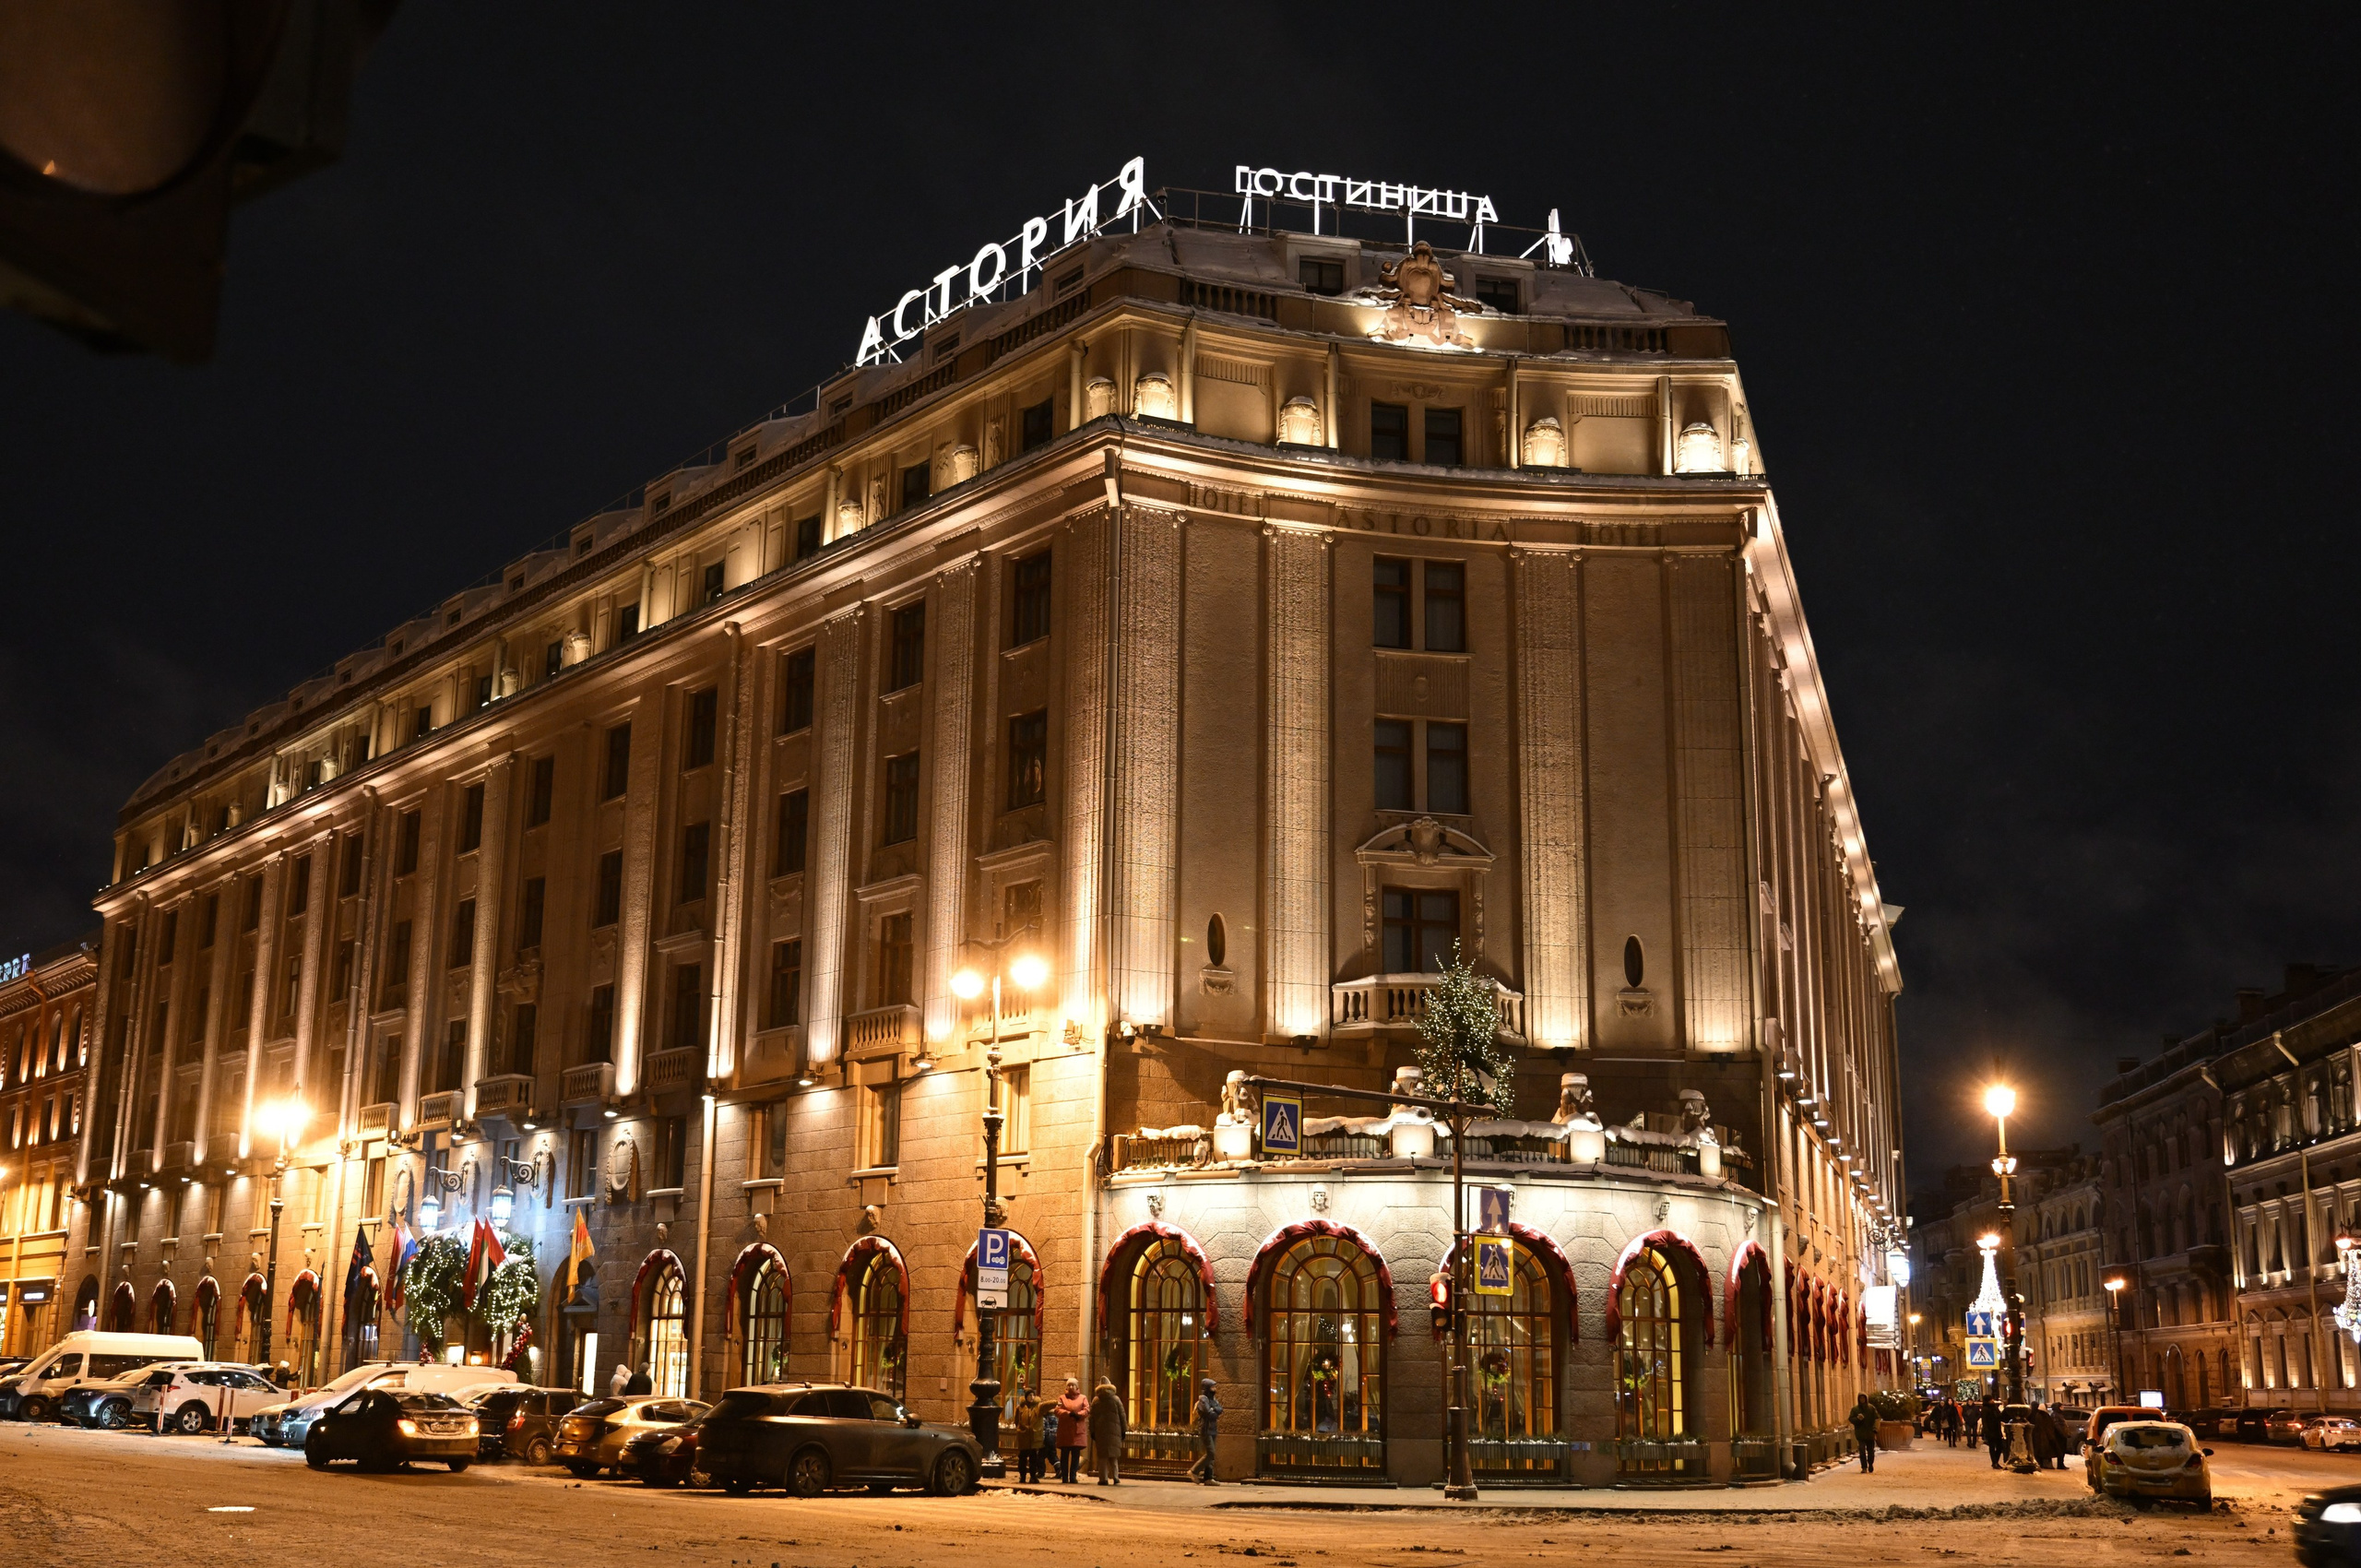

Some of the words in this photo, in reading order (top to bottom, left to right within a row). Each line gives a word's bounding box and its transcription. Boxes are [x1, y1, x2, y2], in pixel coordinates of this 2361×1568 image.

[1236, 165, 1499, 223] ГОСТИНИЦА
[855, 155, 1145, 367] АСТОРИЯ
[1335, 508, 1509, 541] ASTORIA
[986, 1233, 1003, 1264] P
